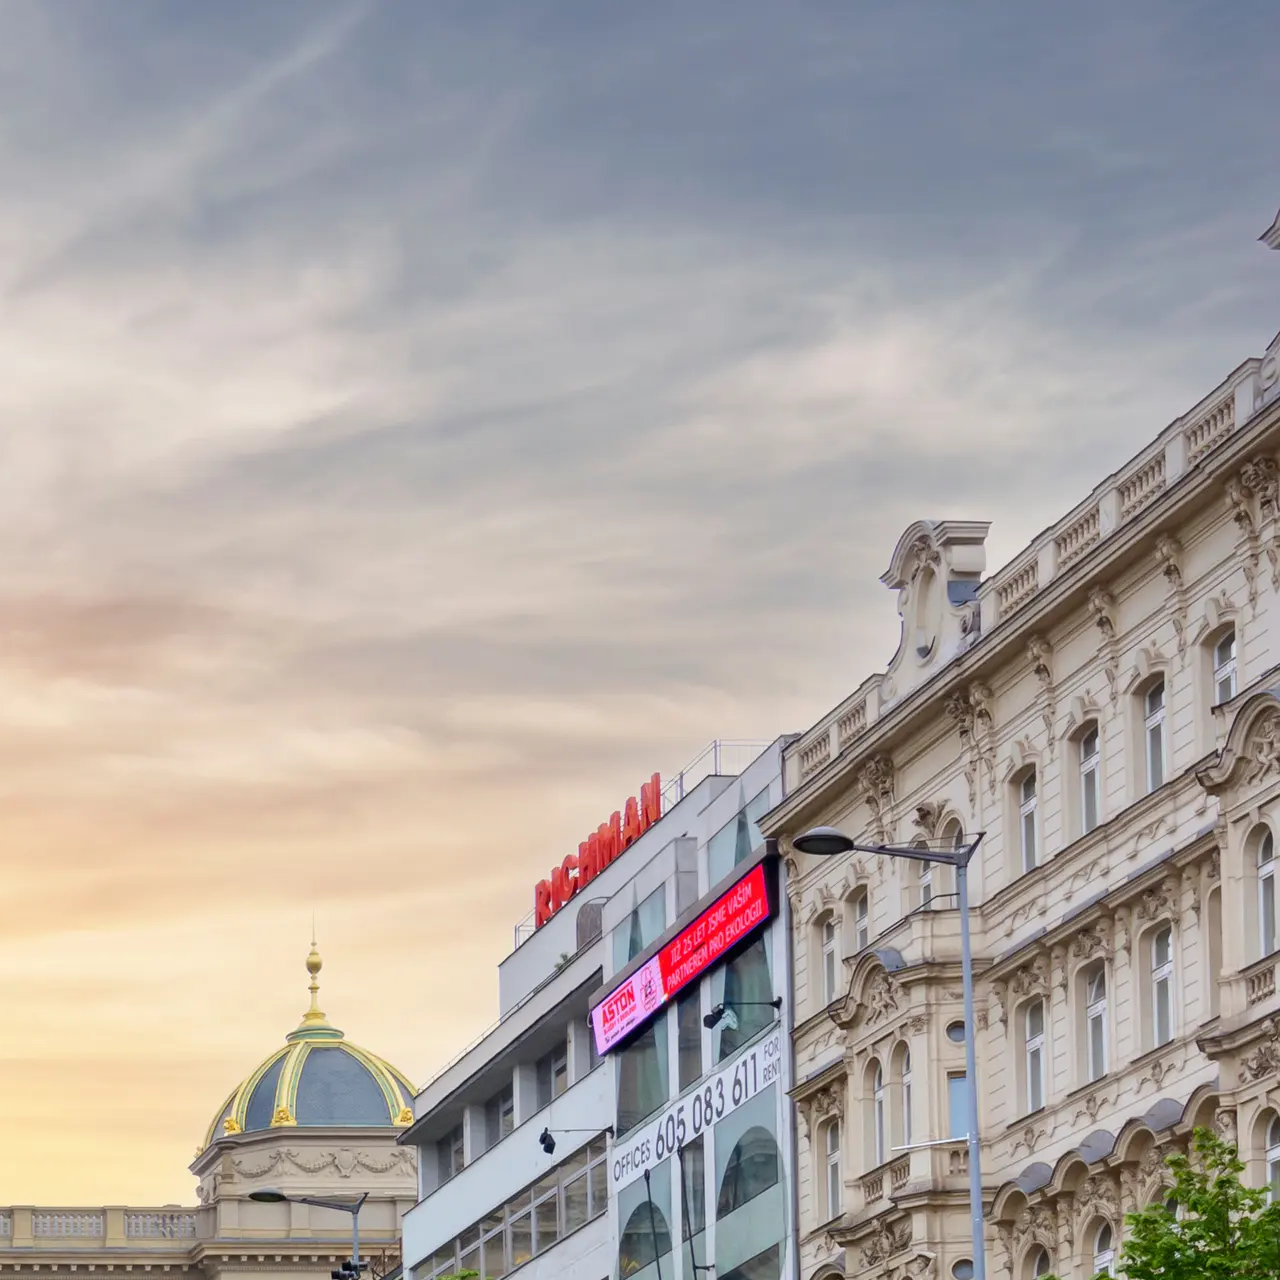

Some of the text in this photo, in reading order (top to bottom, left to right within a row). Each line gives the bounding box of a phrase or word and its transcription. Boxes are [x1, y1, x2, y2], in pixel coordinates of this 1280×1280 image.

[535, 772, 661, 929] RICHMAN
[666, 899, 762, 990] PARTNEREM PRO EKOLOGII
[693, 922, 706, 946] LET
[707, 905, 726, 934] JSME
[602, 985, 635, 1028] ASTON
[763, 1036, 779, 1061] FOR
[762, 1057, 781, 1084] RENT
[613, 1052, 757, 1182] OFFICES 605 083 611
